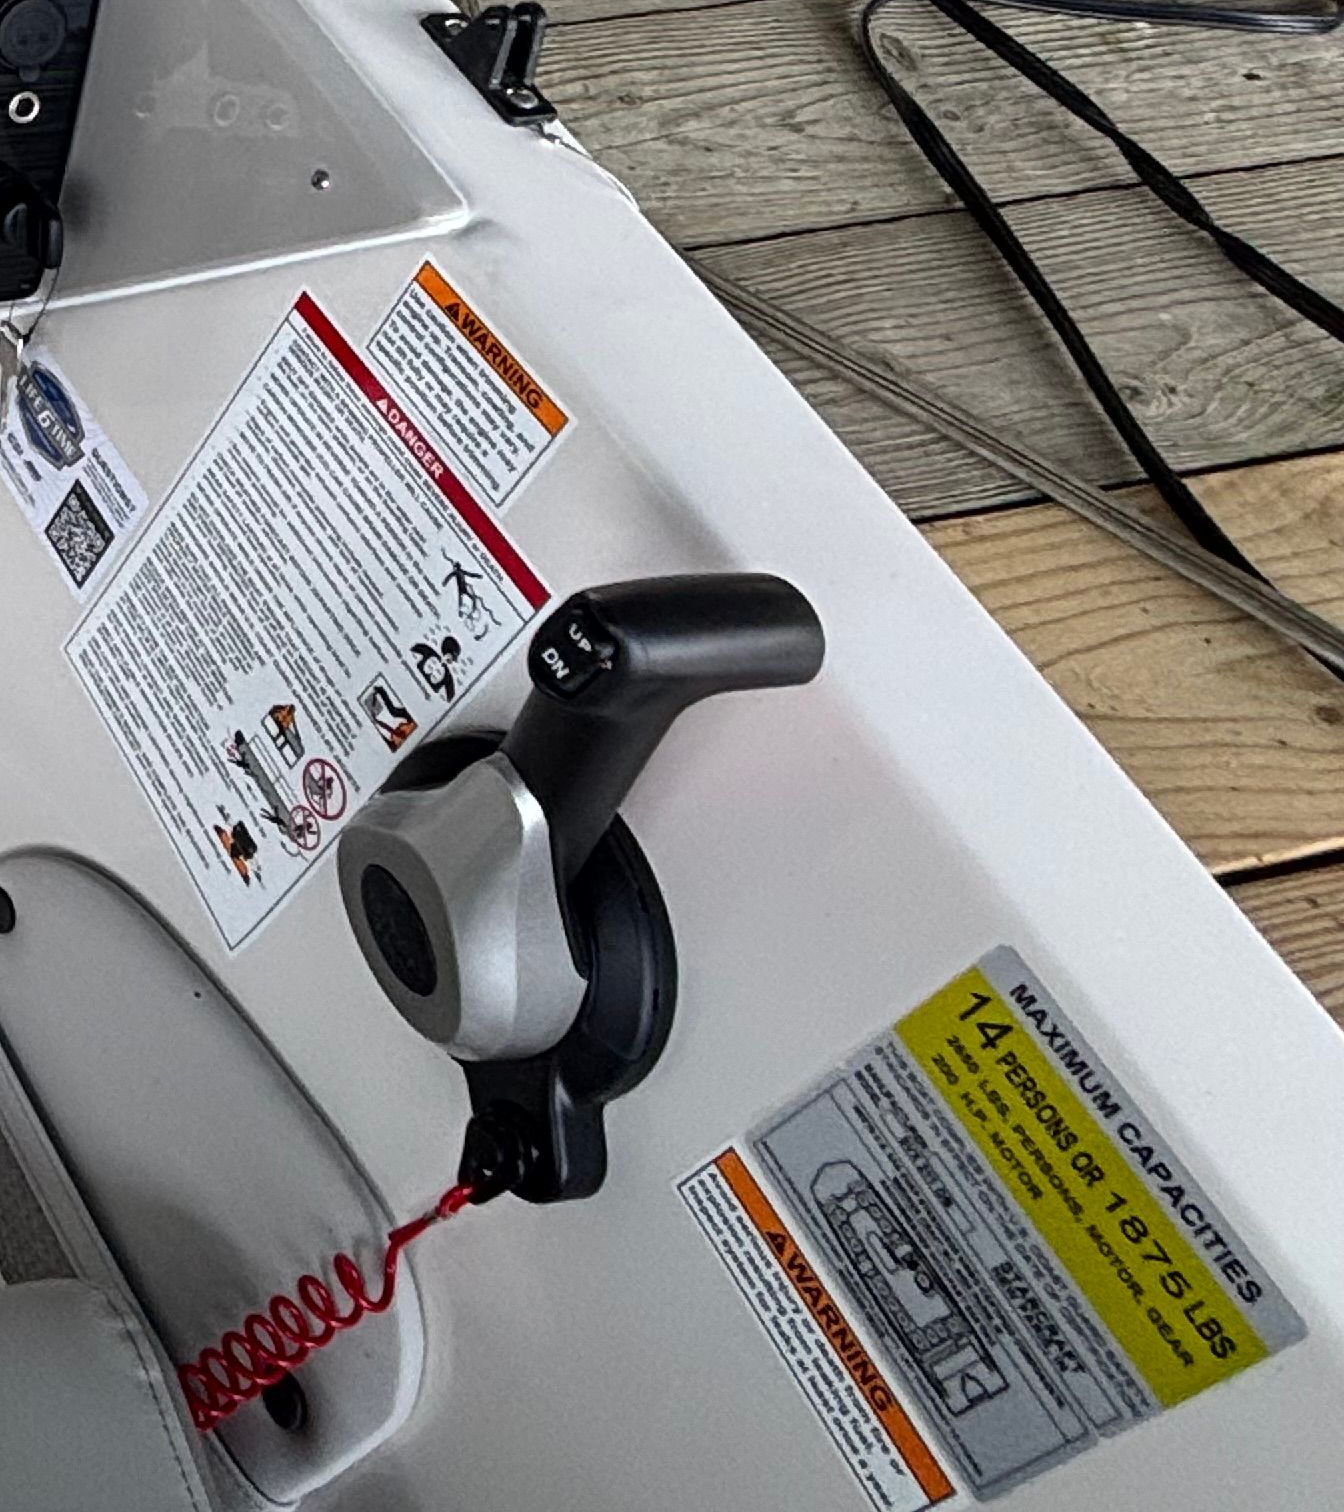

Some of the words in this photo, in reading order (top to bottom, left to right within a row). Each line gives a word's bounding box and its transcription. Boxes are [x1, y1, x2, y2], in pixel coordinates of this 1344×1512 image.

[457, 311, 545, 411] WARNING
[385, 405, 445, 480] DANGER
[541, 647, 570, 680] DN
[569, 623, 592, 652] UP
[950, 985, 1018, 1055] 14
[992, 1048, 1081, 1154] PERSONS
[1067, 1147, 1108, 1188] OR
[1097, 1188, 1196, 1303] 1875
[1180, 1298, 1241, 1362] LBS
[986, 1130, 1045, 1202] MOTOR
[1007, 981, 1124, 1120] MAXIMUM
[1111, 1119, 1269, 1307] CAPACITIES
[779, 1251, 897, 1413] WARNING
[1143, 1304, 1198, 1368] GEAR
